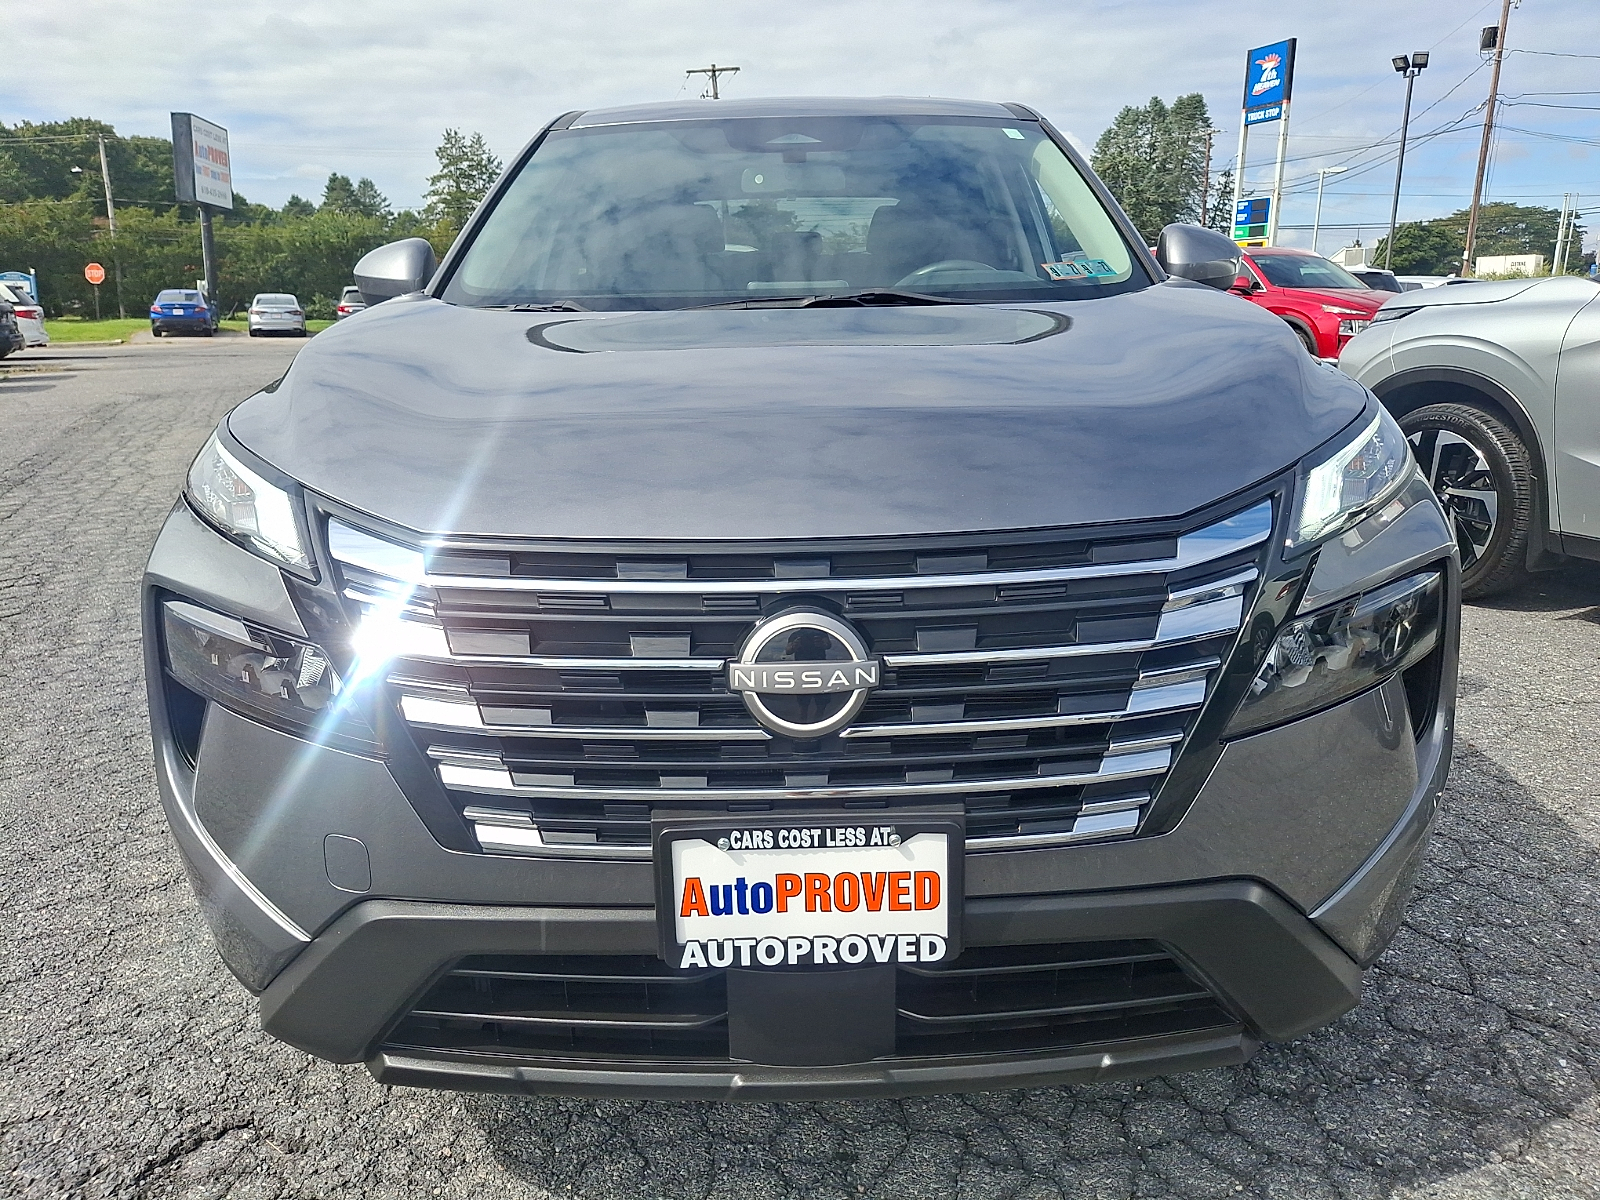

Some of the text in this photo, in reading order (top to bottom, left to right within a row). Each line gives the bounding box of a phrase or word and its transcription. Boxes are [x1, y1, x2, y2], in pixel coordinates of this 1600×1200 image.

[1261, 61, 1277, 82] 7th
[1247, 107, 1280, 122] TRUCK STOP
[86, 269, 104, 278] STOP
[734, 666, 876, 688] NISSAN
[730, 826, 891, 849] CARS COST LESS AT
[680, 870, 941, 917] AutoPROVED
[679, 934, 947, 969] AUTOPROVED
